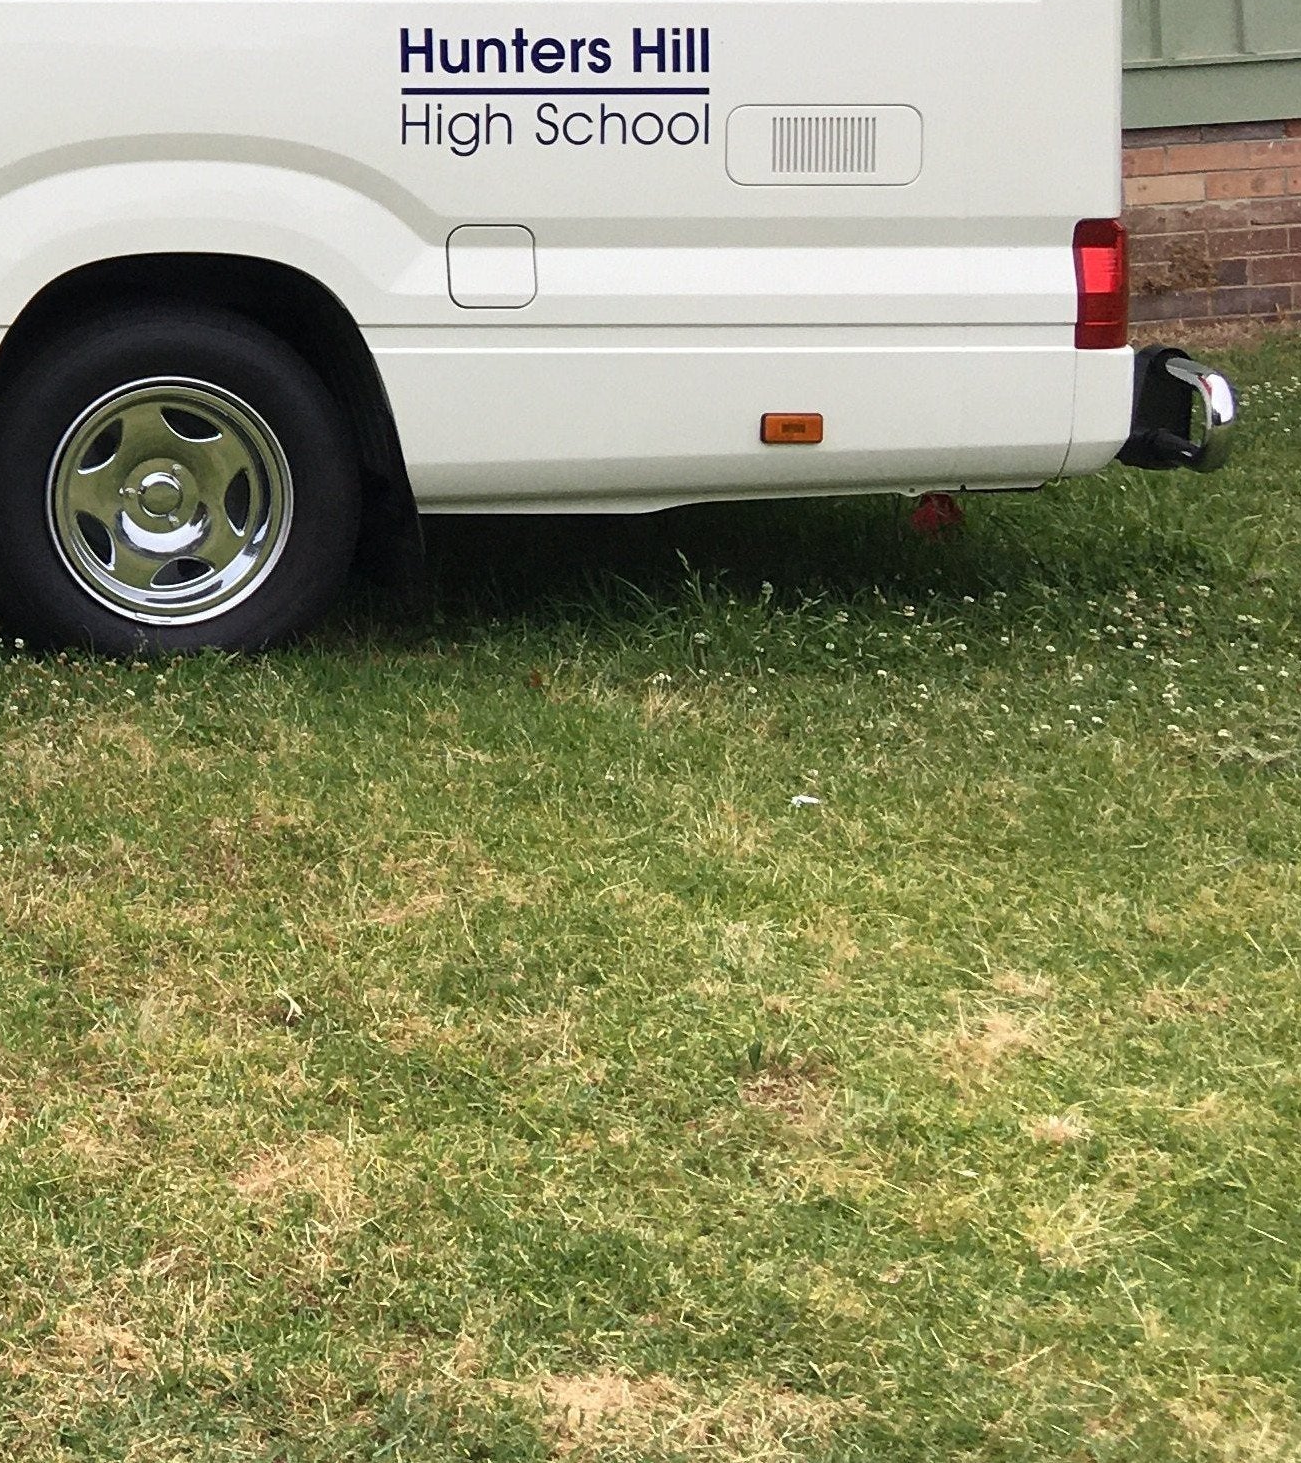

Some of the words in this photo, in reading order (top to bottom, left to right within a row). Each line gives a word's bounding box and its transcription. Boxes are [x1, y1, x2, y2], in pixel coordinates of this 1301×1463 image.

[401, 28, 611, 73] Hunters
[633, 28, 709, 72] Hill
[402, 103, 512, 156] High
[536, 103, 709, 145] School
